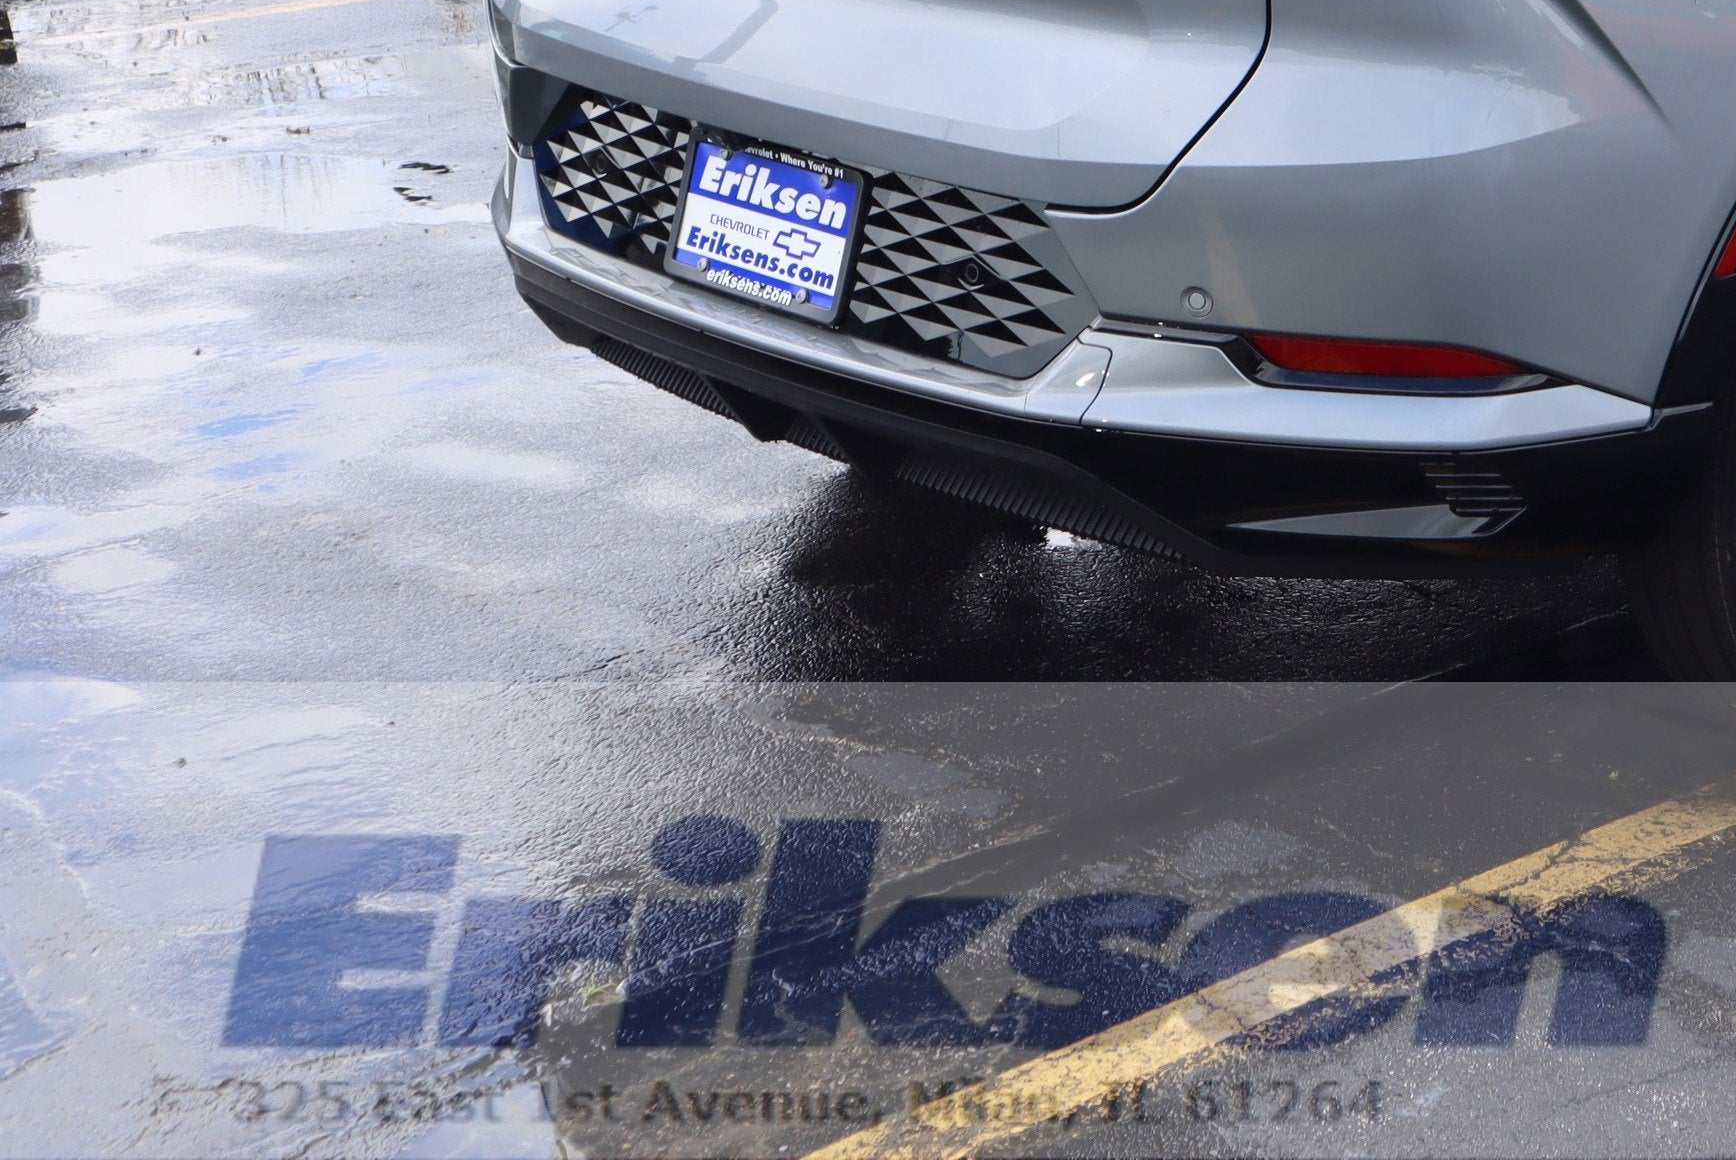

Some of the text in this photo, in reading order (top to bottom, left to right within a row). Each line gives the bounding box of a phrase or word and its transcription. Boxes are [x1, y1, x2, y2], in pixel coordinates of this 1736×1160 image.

[780, 152, 806, 168] Where
[807, 159, 833, 176] You're
[834, 167, 844, 179] #1
[698, 154, 848, 229] Eriksen
[709, 213, 771, 241] CHEVROLET
[686, 226, 835, 290] Eriksens.com
[706, 269, 793, 306] eriksens.com
